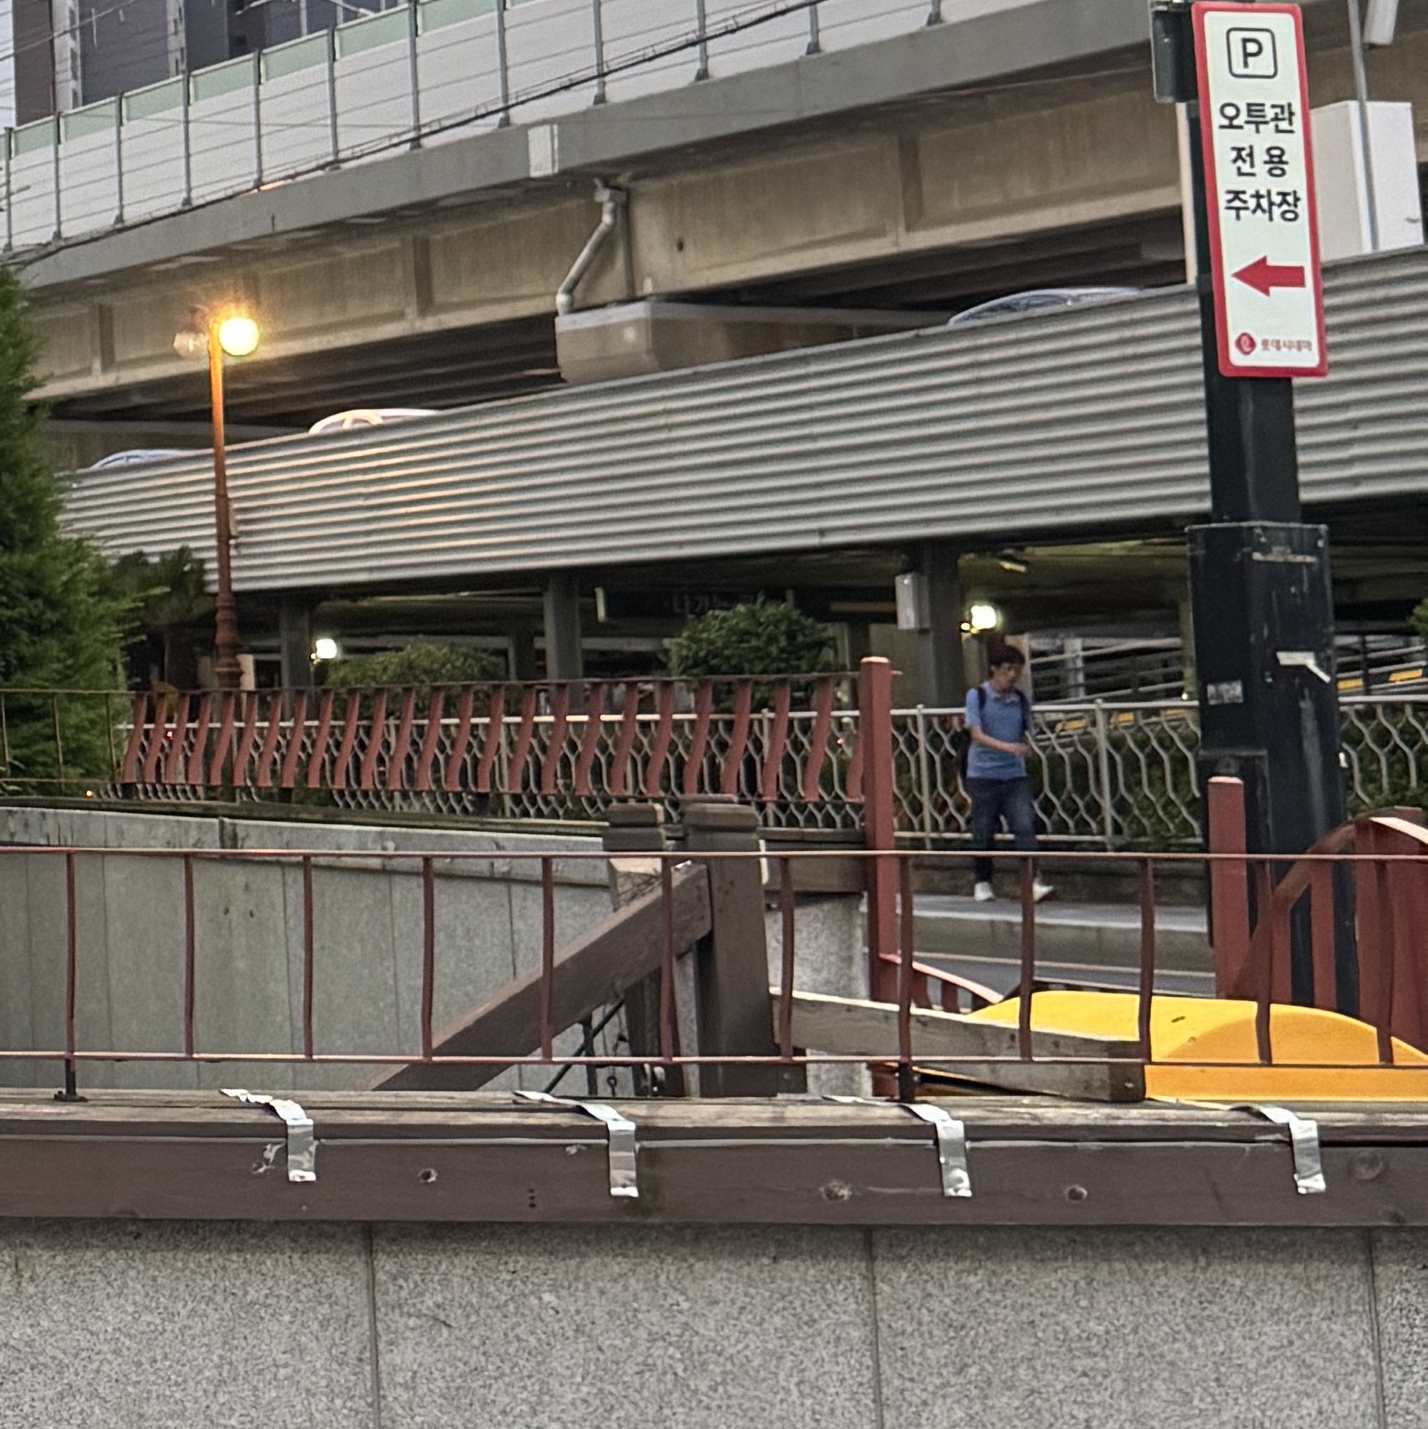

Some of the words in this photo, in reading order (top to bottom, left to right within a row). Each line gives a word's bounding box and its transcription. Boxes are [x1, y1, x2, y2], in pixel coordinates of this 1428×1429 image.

[1240, 37, 1264, 69] P
[1218, 101, 1296, 134] 오투관
[1224, 188, 1301, 222] 주차장
